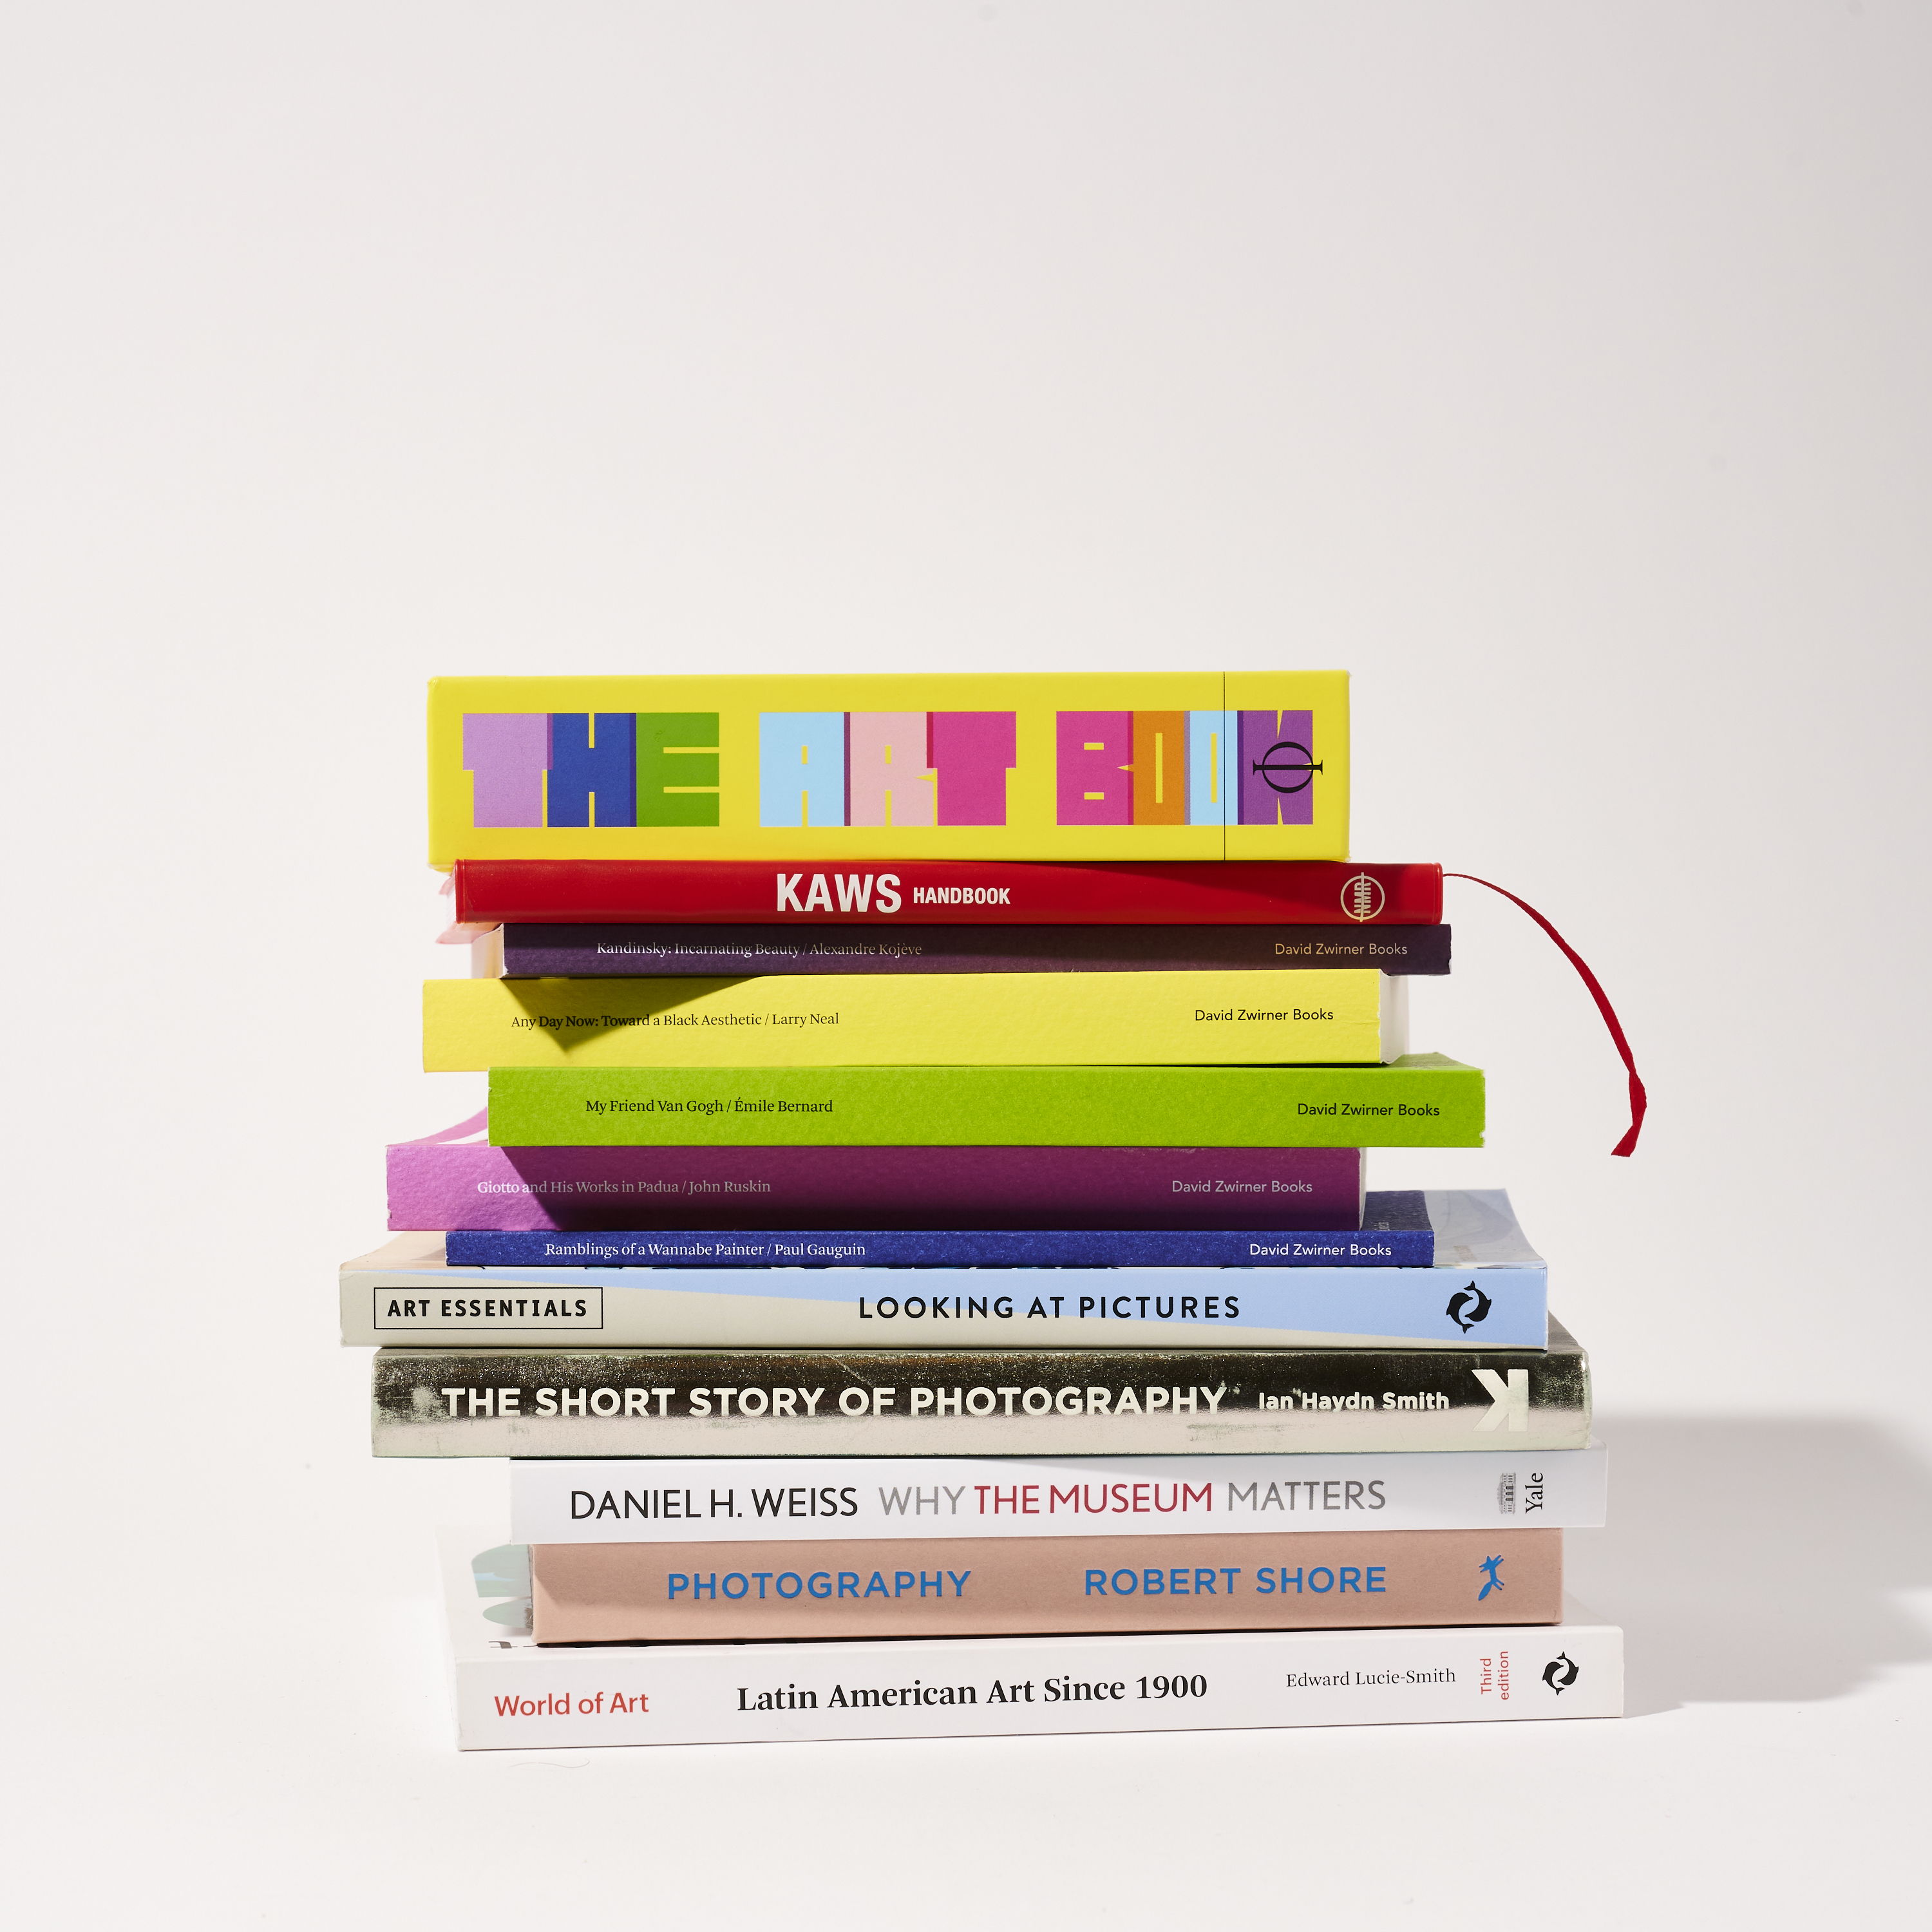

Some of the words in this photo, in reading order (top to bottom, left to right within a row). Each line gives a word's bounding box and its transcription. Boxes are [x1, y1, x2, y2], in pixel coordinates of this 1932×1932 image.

[462, 712, 719, 828] THE
[759, 712, 1016, 826] ART
[1056, 710, 1314, 825] BOOK
[776, 873, 902, 914] KAWS
[913, 886, 1012, 906] HANDBOOK
[596, 942, 672, 958] Kandinsky:
[674, 942, 753, 958] Incarnating
[755, 943, 799, 958] Beauty
[809, 943, 876, 955] Alexandre
[879, 943, 922, 959] Kojève
[1275, 942, 1312, 955] David
[1316, 942, 1365, 955] Zwirner
[1369, 942, 1408, 955] Books
[511, 1015, 536, 1030] Any
[539, 1015, 564, 1030] Day
[566, 1015, 599, 1027] Now:
[601, 1014, 650, 1027] Toward
[652, 1017, 660, 1026] a
[663, 1013, 699, 1026] Black
[701, 1013, 762, 1026] Aesthetic
[772, 1013, 807, 1029] Larry
[810, 1012, 839, 1025] Neal
[1195, 1009, 1233, 1021] David
[1237, 1009, 1289, 1021] Zwirner
[1293, 1007, 1334, 1021] Books
[585, 1100, 607, 1115] My
[609, 1099, 655, 1112] Friend
[657, 1100, 684, 1112] Van
[686, 1099, 724, 1115] Gogh
[734, 1097, 775, 1112] Émile
[777, 1099, 833, 1113] Bernard
[1298, 1103, 1337, 1115] David
[1341, 1103, 1394, 1116] Zwirner
[1398, 1103, 1441, 1117] Books
[477, 1180, 519, 1194] Giotto
[522, 1180, 547, 1194] and
[551, 1180, 573, 1193] His
[575, 1180, 619, 1193] Works
[621, 1180, 634, 1193] in
[638, 1180, 679, 1193] Padua
[688, 1180, 721, 1196] John
[723, 1179, 771, 1193] Ruskin
[1172, 1179, 1211, 1193] David
[1215, 1180, 1267, 1193] Zwirner
[1271, 1179, 1313, 1193] Books
[545, 1242, 618, 1260] Ramblings
[621, 1242, 636, 1256] of
[638, 1246, 646, 1256] a
[648, 1242, 712, 1256] Wannabe
[715, 1243, 764, 1256] Painter
[774, 1242, 804, 1256] Paul
[807, 1243, 866, 1260] Gauguin
[1249, 1243, 1289, 1256] David
[1293, 1244, 1346, 1256] Zwirner
[1350, 1243, 1392, 1256] Books
[387, 1299, 430, 1318] ART
[441, 1299, 587, 1318] ESSENTIALS
[859, 1296, 1013, 1319] LOOKING
[1026, 1296, 1065, 1319] AT
[1079, 1296, 1240, 1319] PICTURES
[441, 1387, 521, 1417] THE
[535, 1388, 676, 1417] SHORT
[689, 1388, 825, 1416] STORY
[838, 1387, 895, 1416] OF
[911, 1386, 1226, 1416] PHOTOGRAPHY
[1259, 1392, 1293, 1410] Ian
[1301, 1391, 1374, 1412] Haydn
[1381, 1391, 1450, 1410] Smith
[571, 1489, 702, 1519] DANIEL
[710, 1489, 743, 1518] H.
[750, 1487, 858, 1517] WEISS
[878, 1486, 965, 1515] WHY
[973, 1484, 1041, 1515] THE
[1049, 1482, 1212, 1513] MUSEUM
[1227, 1480, 1387, 1511] MATTERS
[1524, 1472, 1544, 1515] Yale
[667, 1570, 972, 1600] PHOTOGRAPHY
[1084, 1567, 1242, 1596] ROBERT
[1255, 1566, 1387, 1595] SHORE
[1286, 1671, 1350, 1687] Edward
[1355, 1667, 1457, 1685] Lucie-Smith
[1479, 1658, 1492, 1695] Third
[1497, 1651, 1510, 1700] edition
[737, 1683, 819, 1711] Latin
[826, 1679, 978, 1709] American
[985, 1679, 1036, 1704] Art
[1044, 1674, 1126, 1702] Since
[1135, 1674, 1208, 1700] 1900
[494, 1692, 570, 1717] World
[578, 1691, 604, 1714] of
[609, 1692, 650, 1714] Art
